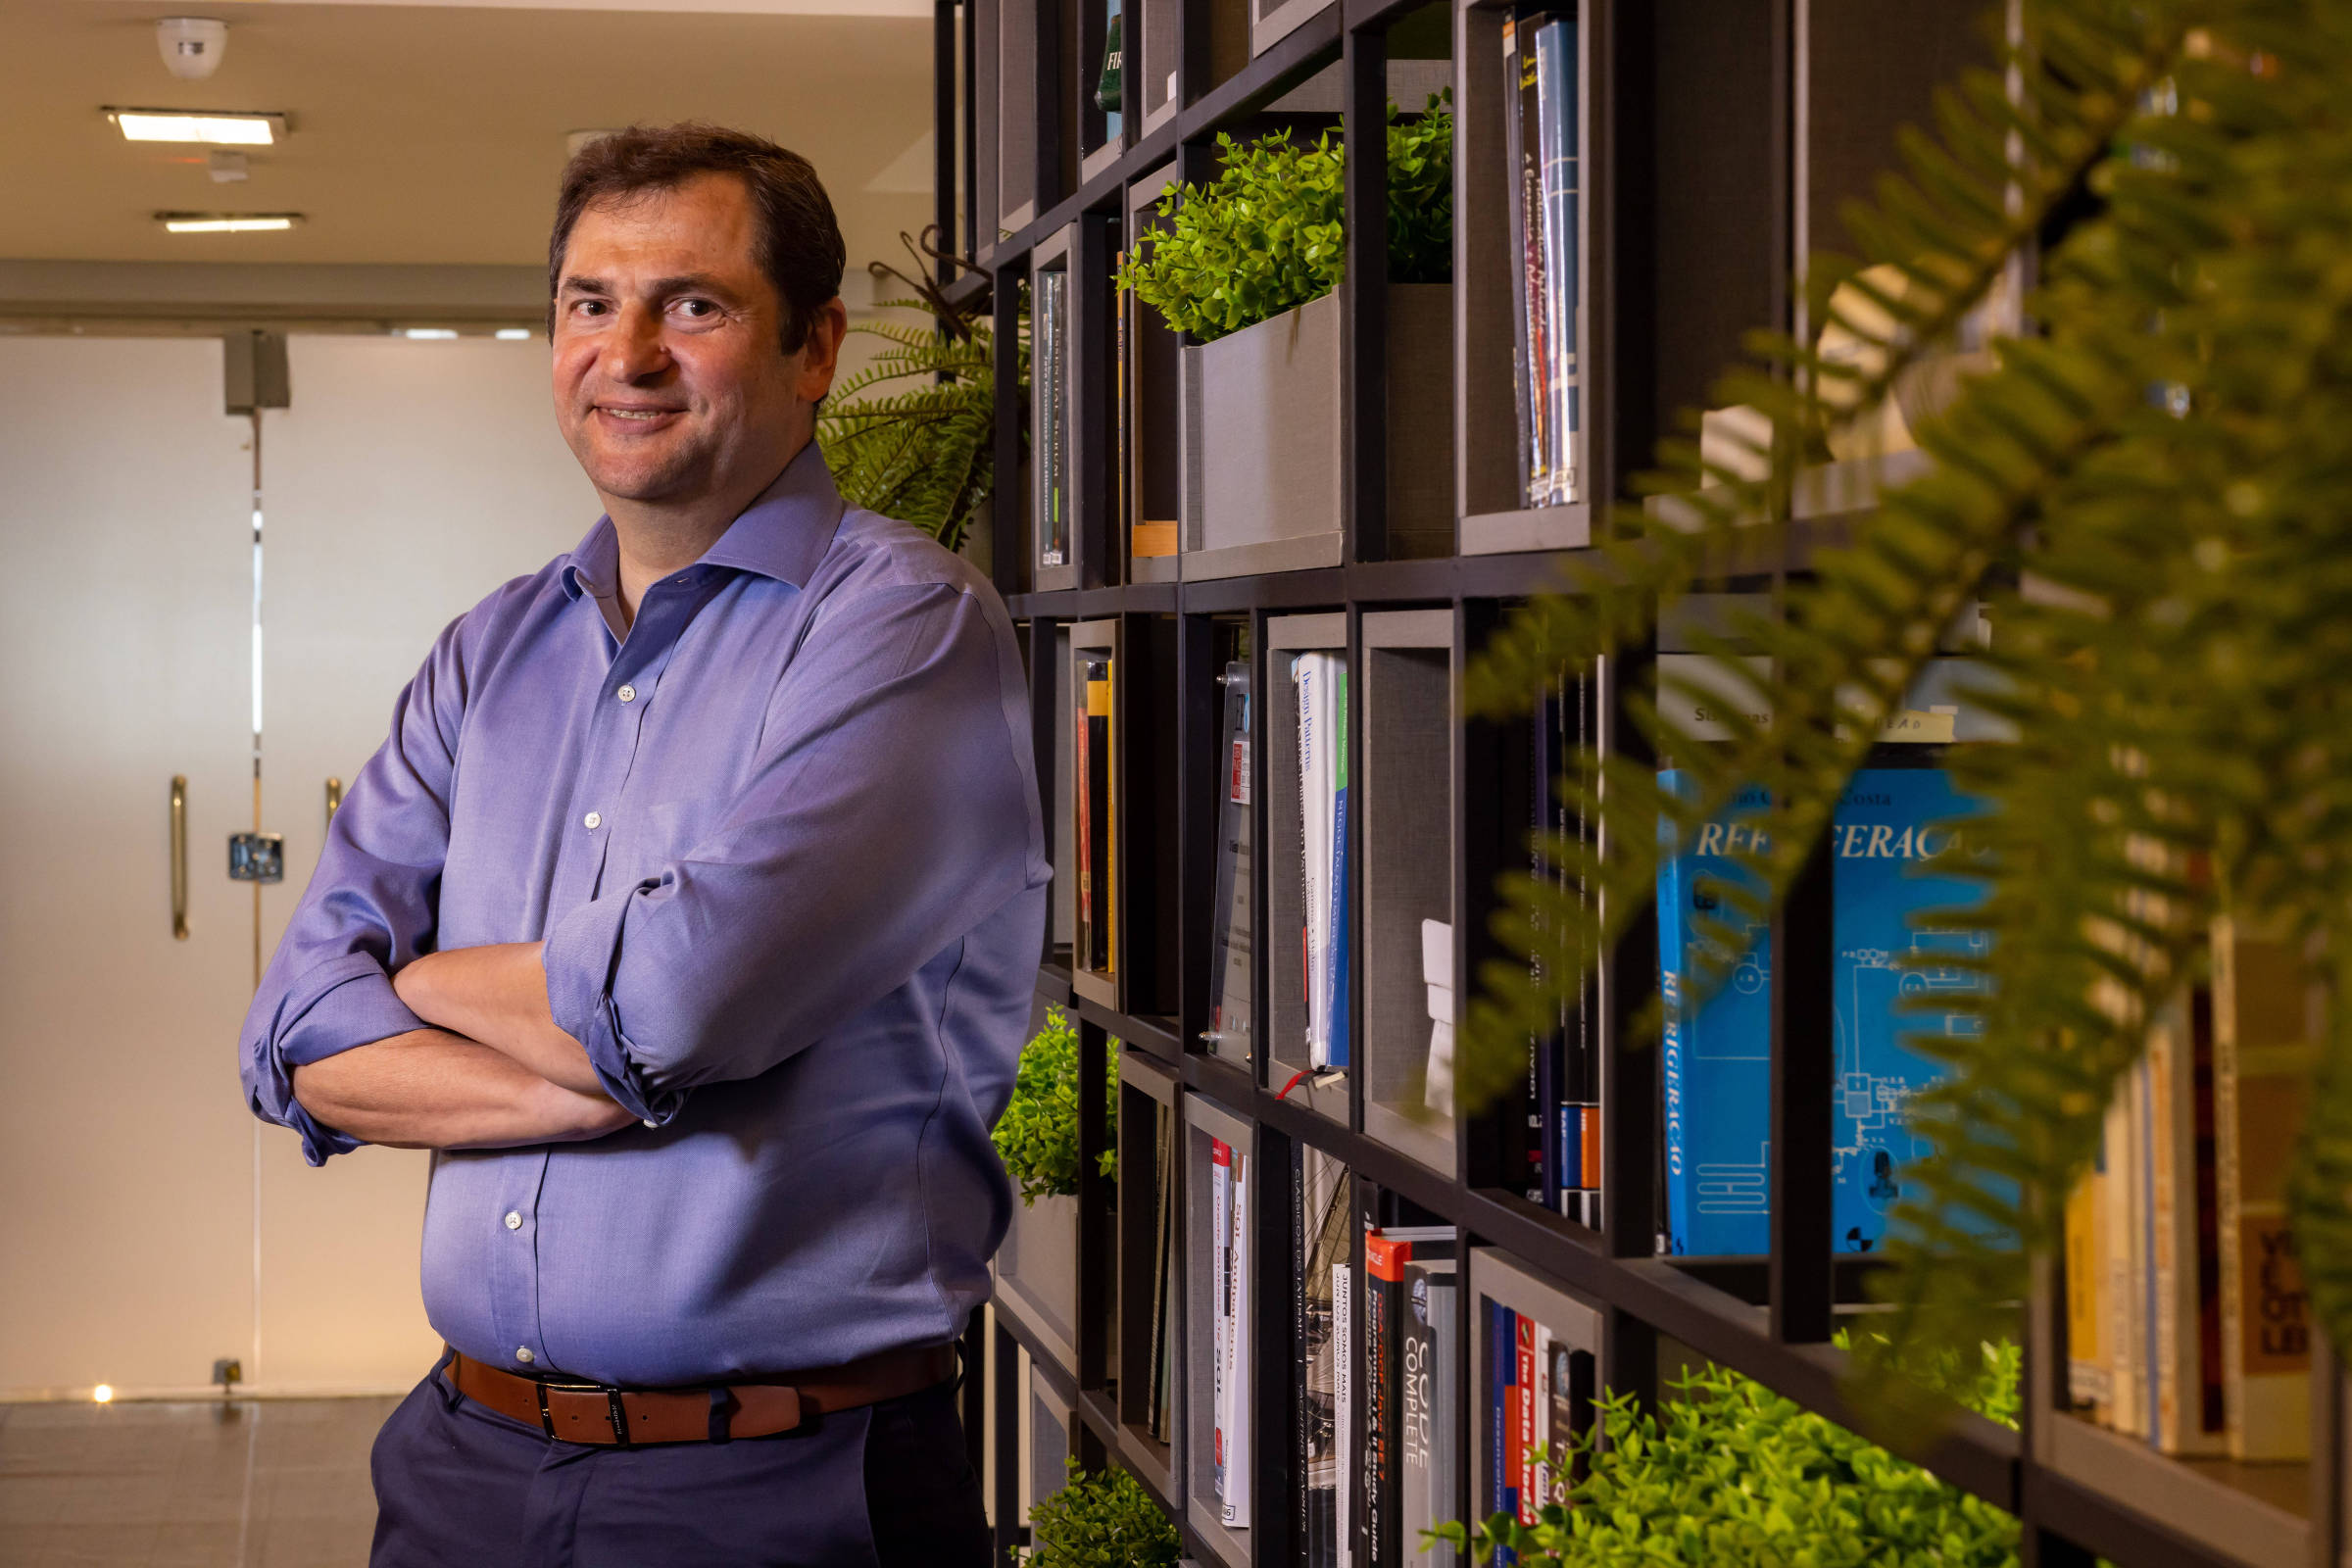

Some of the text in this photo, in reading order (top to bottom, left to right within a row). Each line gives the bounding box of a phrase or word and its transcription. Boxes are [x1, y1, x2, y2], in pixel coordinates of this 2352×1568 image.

[1301, 670, 1315, 773] Design Patterns
[1234, 1203, 1243, 1245] SQL
[1521, 1354, 1530, 1384] The
[1405, 1337, 1418, 1465] COMPLETE
[1521, 1387, 1531, 1444] Data
